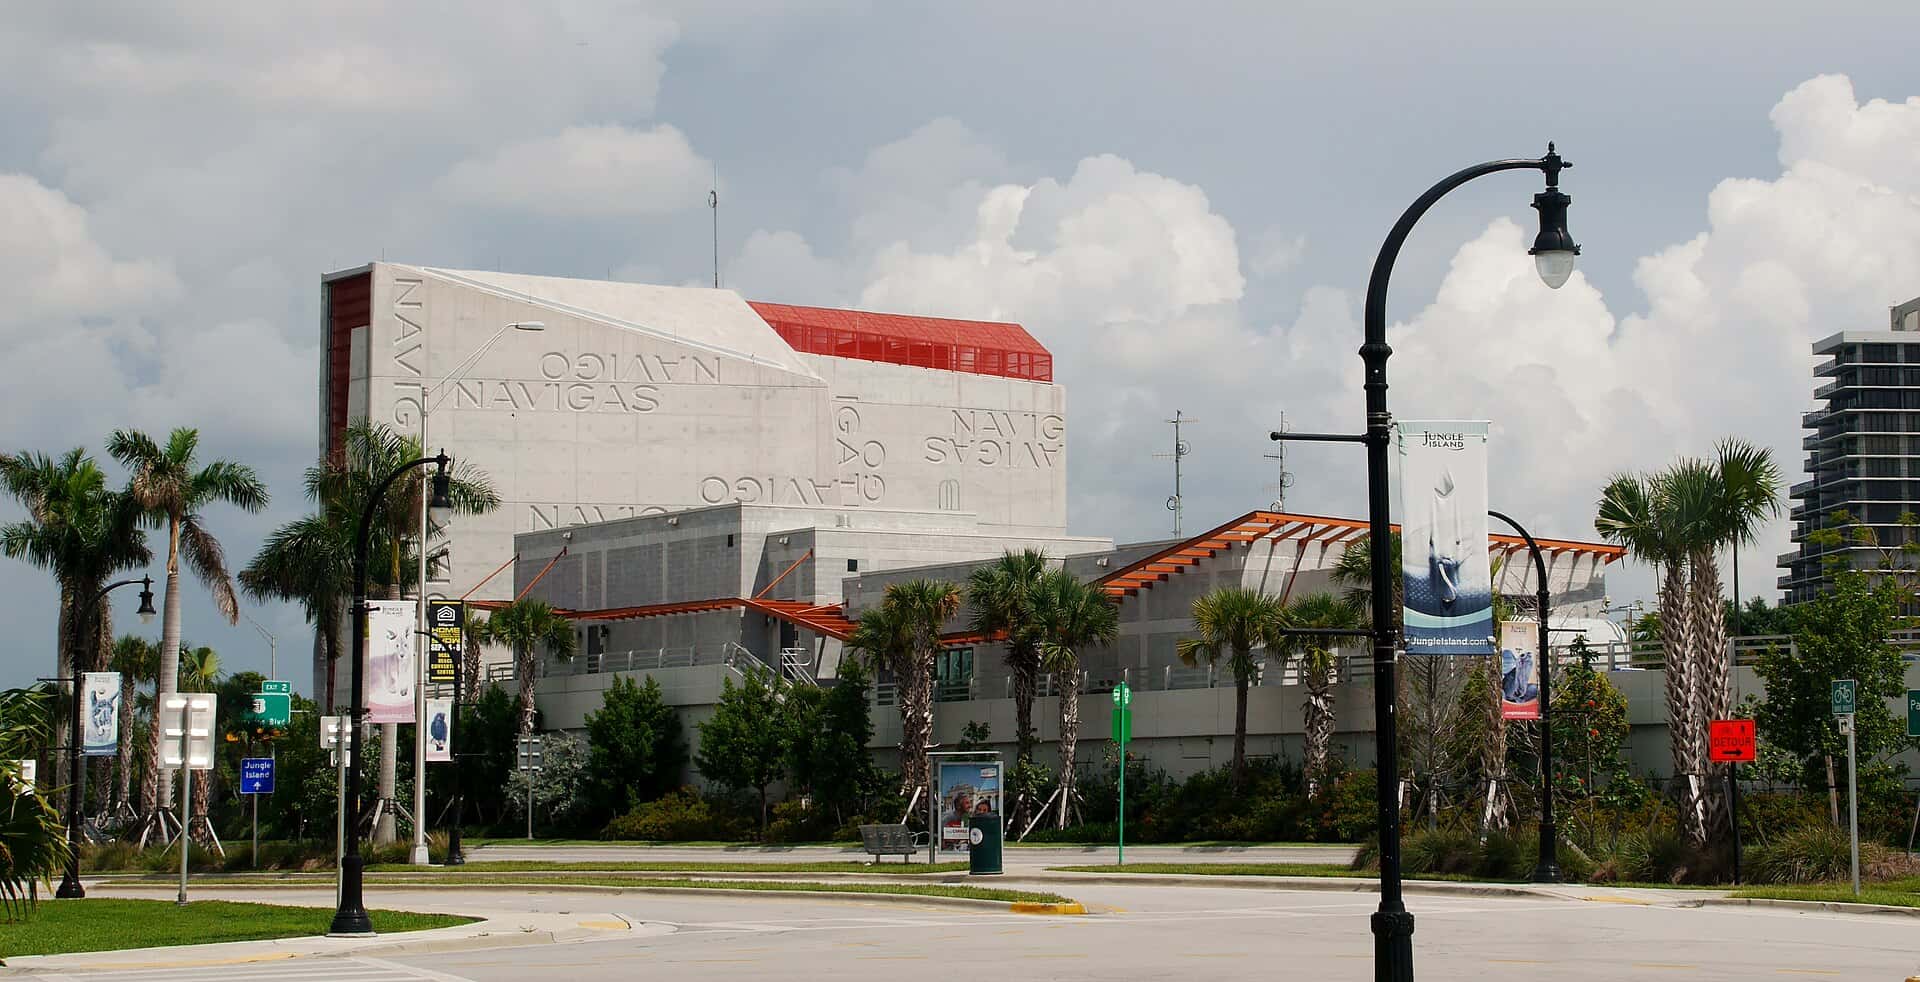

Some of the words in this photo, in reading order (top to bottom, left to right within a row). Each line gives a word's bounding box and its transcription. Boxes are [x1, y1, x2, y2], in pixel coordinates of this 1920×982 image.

[453, 380, 661, 412] NAVIGAS
[1422, 430, 1465, 446] JUNGLE
[1429, 440, 1465, 448] ISLAND
[1411, 637, 1489, 647] JungleIsland.com
[281, 683, 288, 691] 2
[1713, 736, 1752, 747] DETOUR
[245, 761, 271, 771] Jungle
[245, 771, 270, 779] Island
